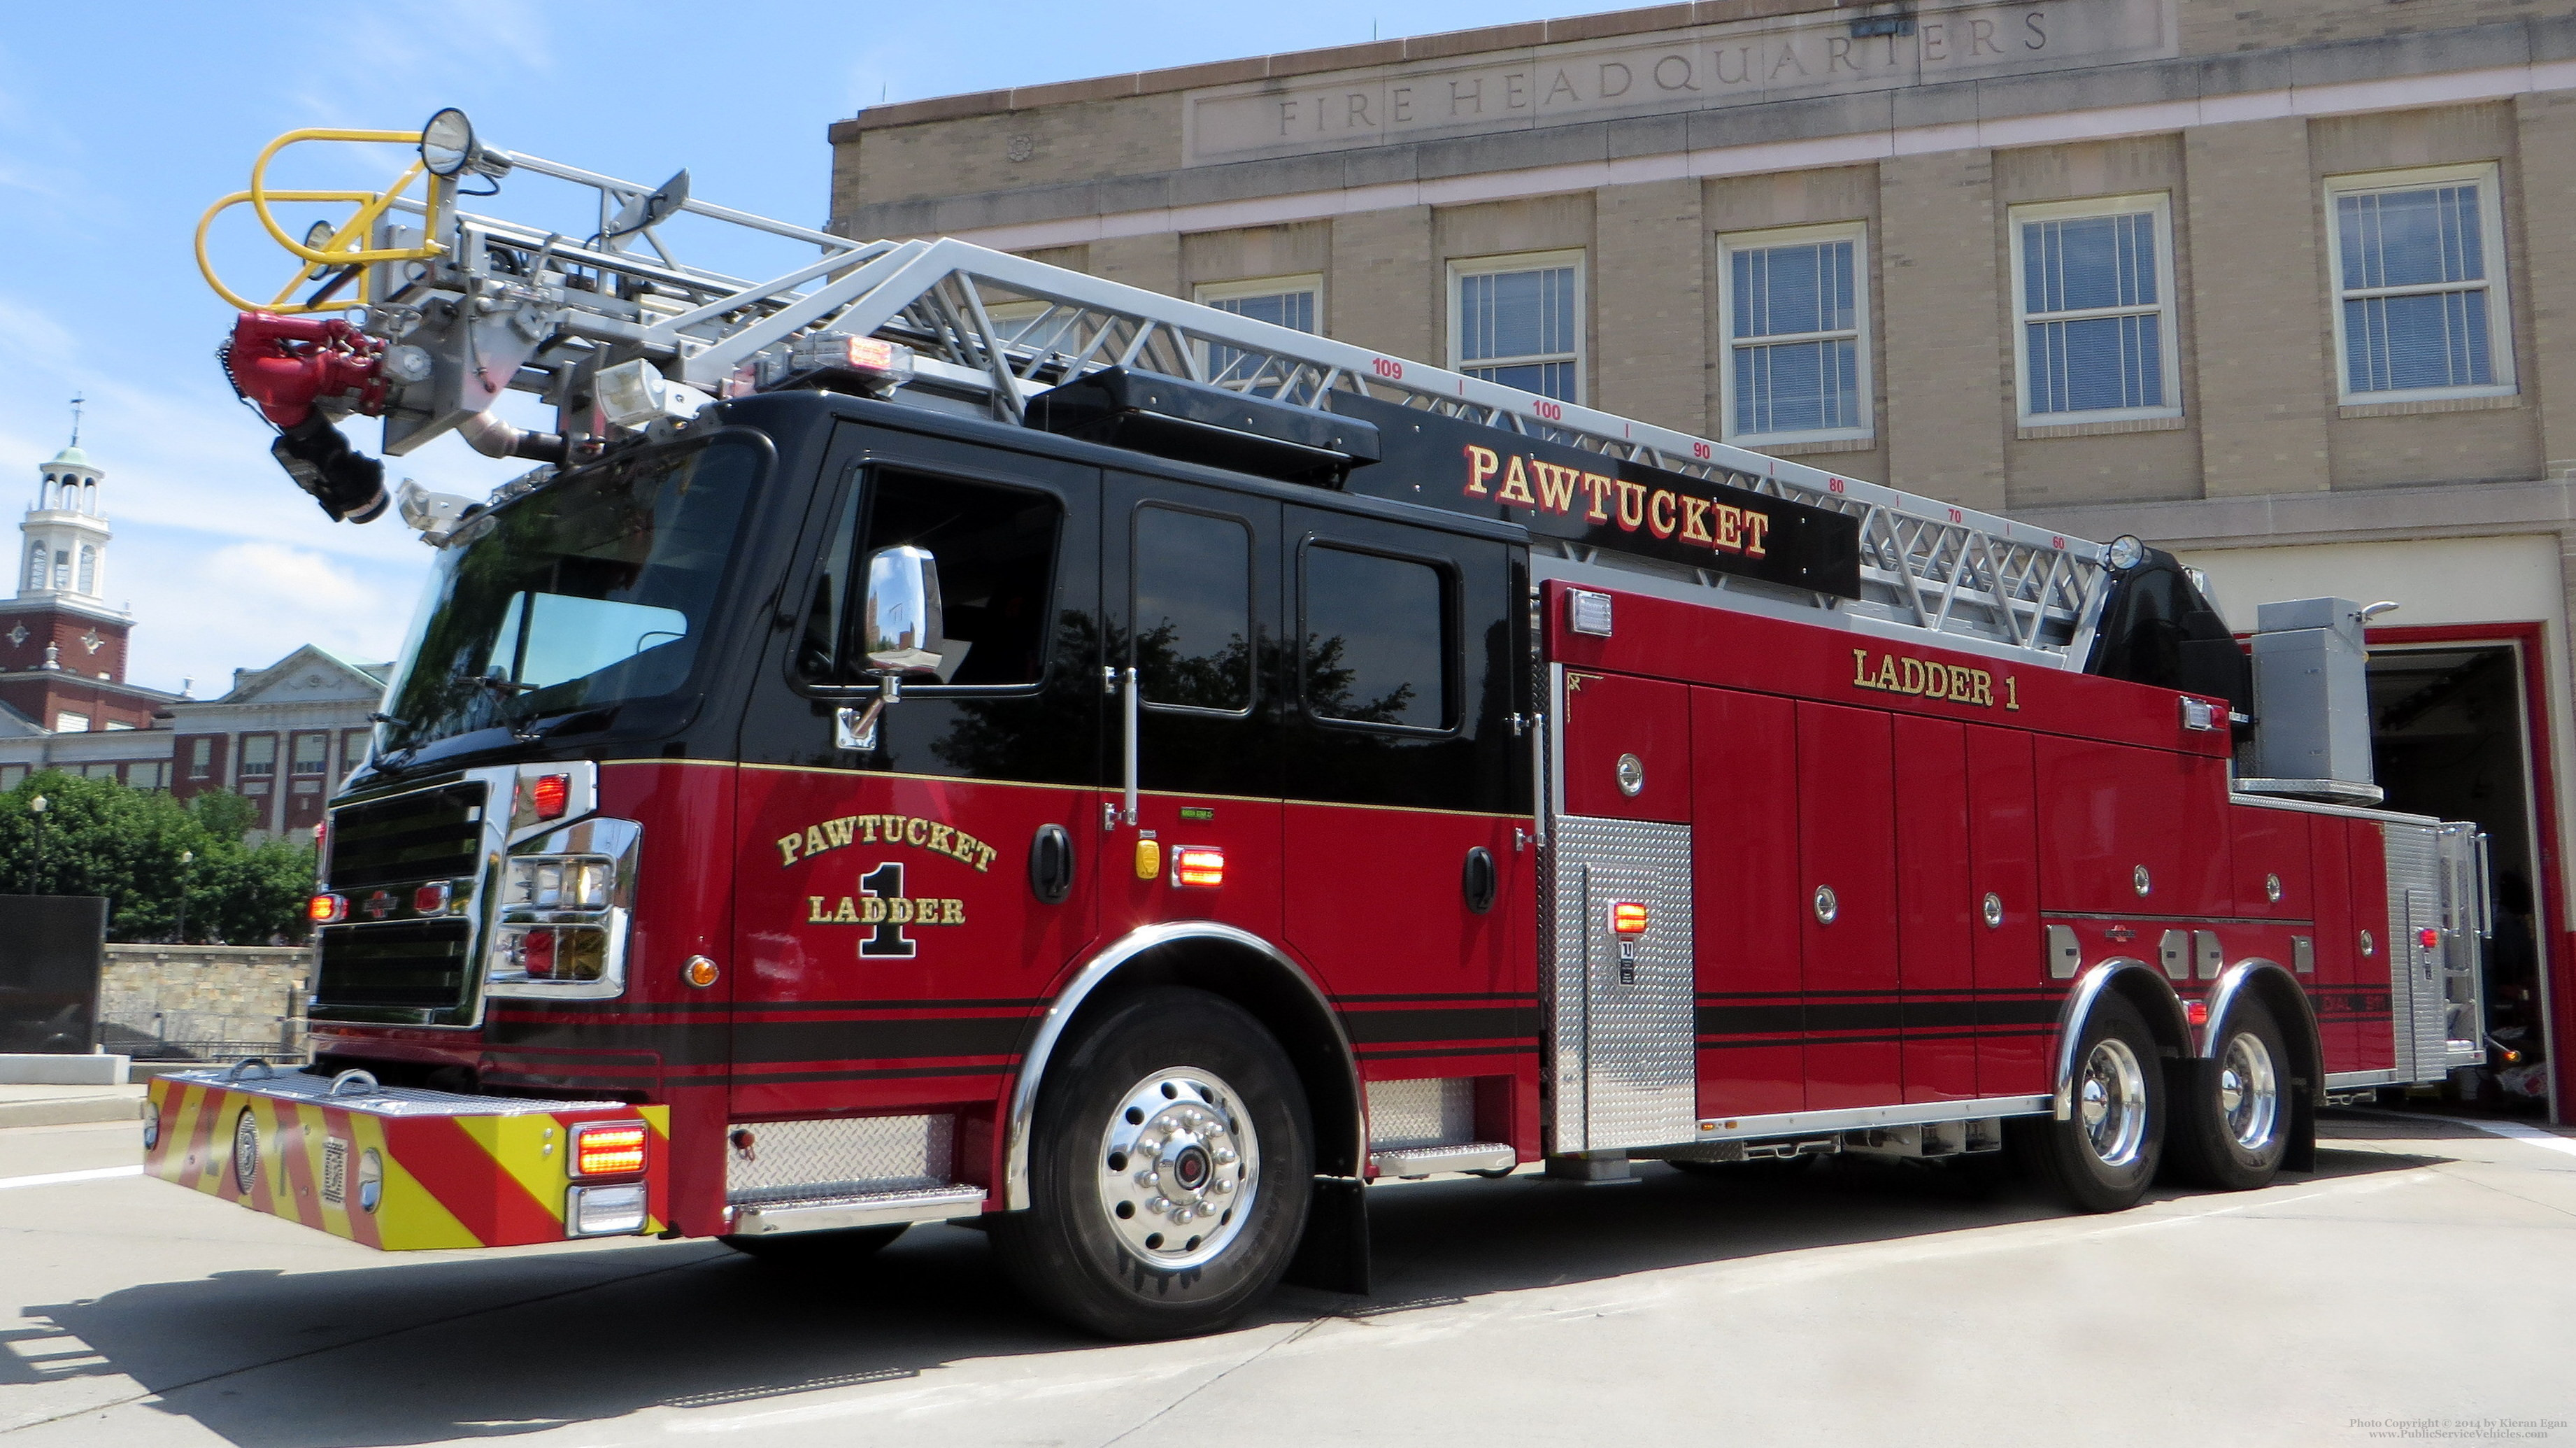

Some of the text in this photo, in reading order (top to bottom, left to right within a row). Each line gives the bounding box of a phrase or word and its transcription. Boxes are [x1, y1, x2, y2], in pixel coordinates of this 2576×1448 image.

[1278, 11, 2047, 136] FIRE HEADQUARTERS
[1372, 357, 1402, 380] 109
[1532, 399, 1561, 420] 100
[1693, 441, 1711, 460] 90
[1828, 477, 1844, 494] 80
[1463, 443, 1770, 559] PAWTUCKET
[1948, 508, 1962, 524] 70
[2052, 535, 2065, 550] 60
[1853, 648, 2020, 711] LADDER 1
[776, 814, 998, 873] PAWTUCKET
[807, 895, 967, 925] LADDER
[860, 862, 917, 959] 1
